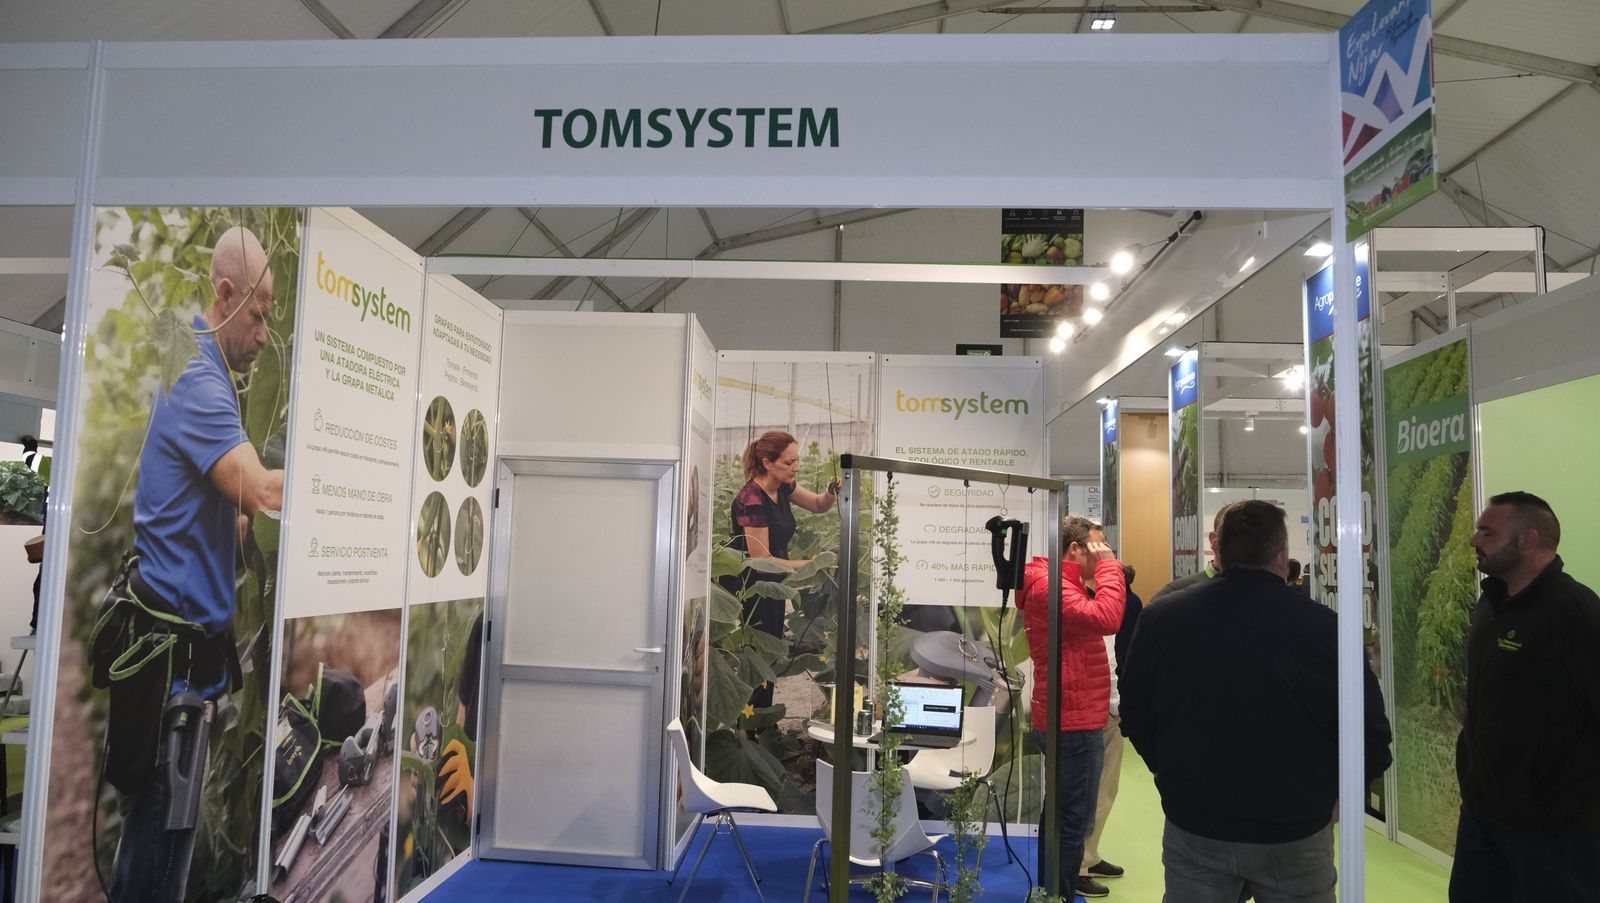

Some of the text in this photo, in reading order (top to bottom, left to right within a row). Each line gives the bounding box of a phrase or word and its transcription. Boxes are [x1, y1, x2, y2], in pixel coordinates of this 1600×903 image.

[534, 107, 839, 149] TOMSYSTEM
[316, 250, 411, 333] tomsystem
[314, 329, 406, 376] UN SISTEMA COMPUESTO POR
[320, 348, 335, 364] UNA
[336, 355, 367, 376] ATADORA
[325, 367, 330, 379] Y
[331, 368, 340, 383] LA
[342, 374, 364, 391] GRAPA
[896, 389, 1029, 420] tomsystem
[365, 432, 373, 444] DE
[374, 435, 398, 450] COSTES
[1397, 413, 1465, 454] Bioera
[895, 446, 906, 454] EL
[908, 446, 945, 455] SISTEMA
[947, 447, 959, 456] DE
[961, 448, 991, 456] ATADO
[970, 458, 1015, 467] RENTABLE
[322, 484, 393, 503] MENOS MANO DE OBRA
[943, 488, 994, 497] SEGURIDAD
[321, 546, 388, 558] SERVICIO POSTVENTA
